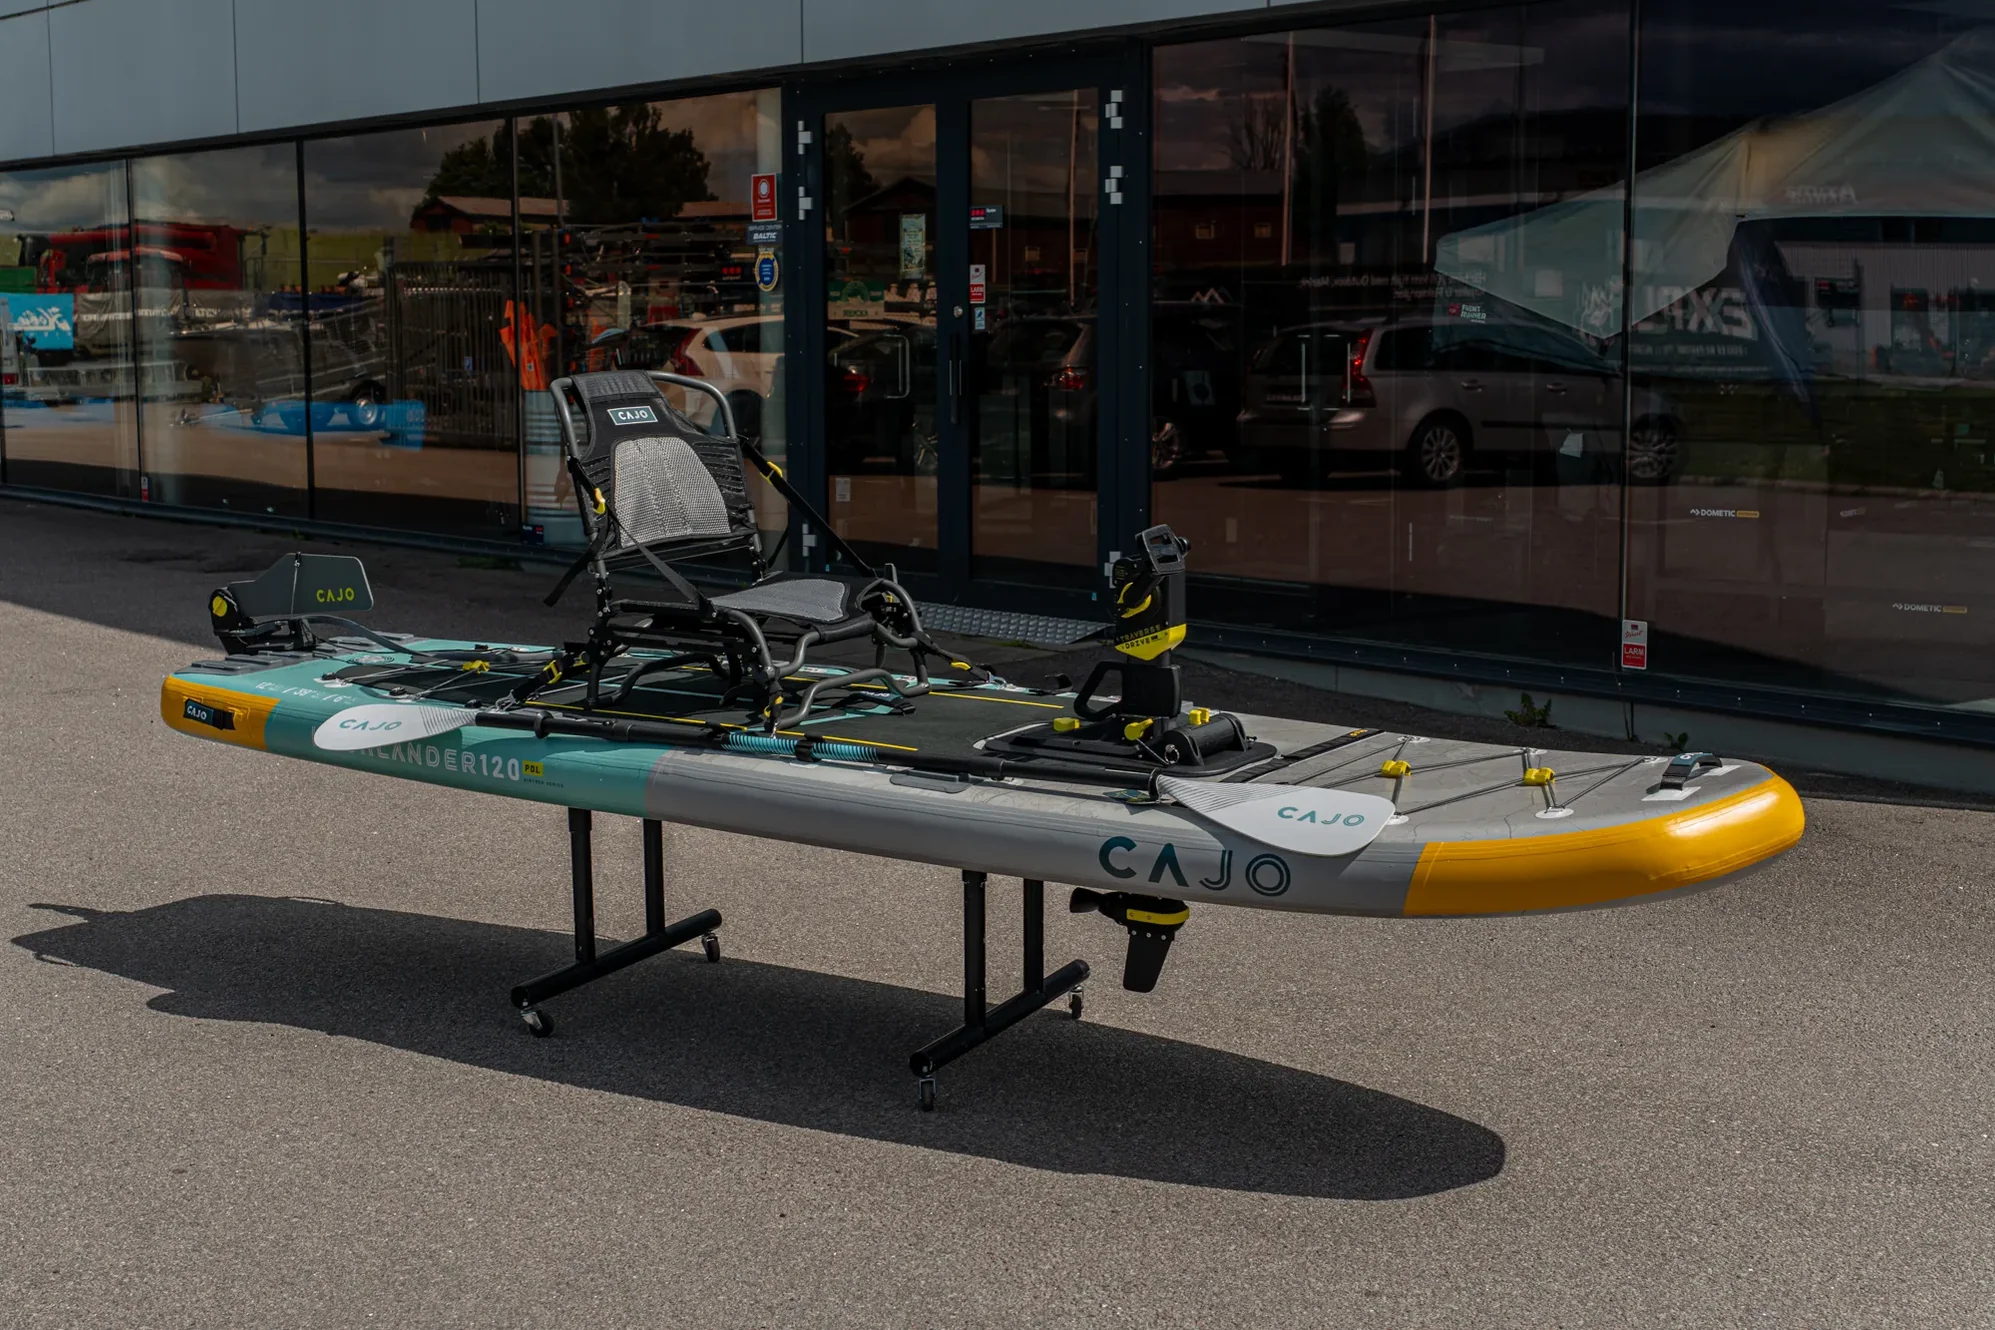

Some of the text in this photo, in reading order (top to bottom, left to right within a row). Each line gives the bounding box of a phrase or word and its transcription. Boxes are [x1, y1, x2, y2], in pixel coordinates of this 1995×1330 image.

[753, 232, 777, 240] BALTIC
[618, 408, 650, 421] CAJO
[1700, 508, 1736, 518] DOMETIC
[316, 586, 356, 604] CAJO
[1904, 603, 1942, 613] DOMETIC
[1125, 637, 1151, 651] DRIVE
[1624, 646, 1644, 655] LARM
[186, 705, 207, 721] CAJO
[339, 719, 402, 731] CAJO
[1277, 805, 1366, 828] CAJO
[1098, 835, 1292, 898] CAJO
